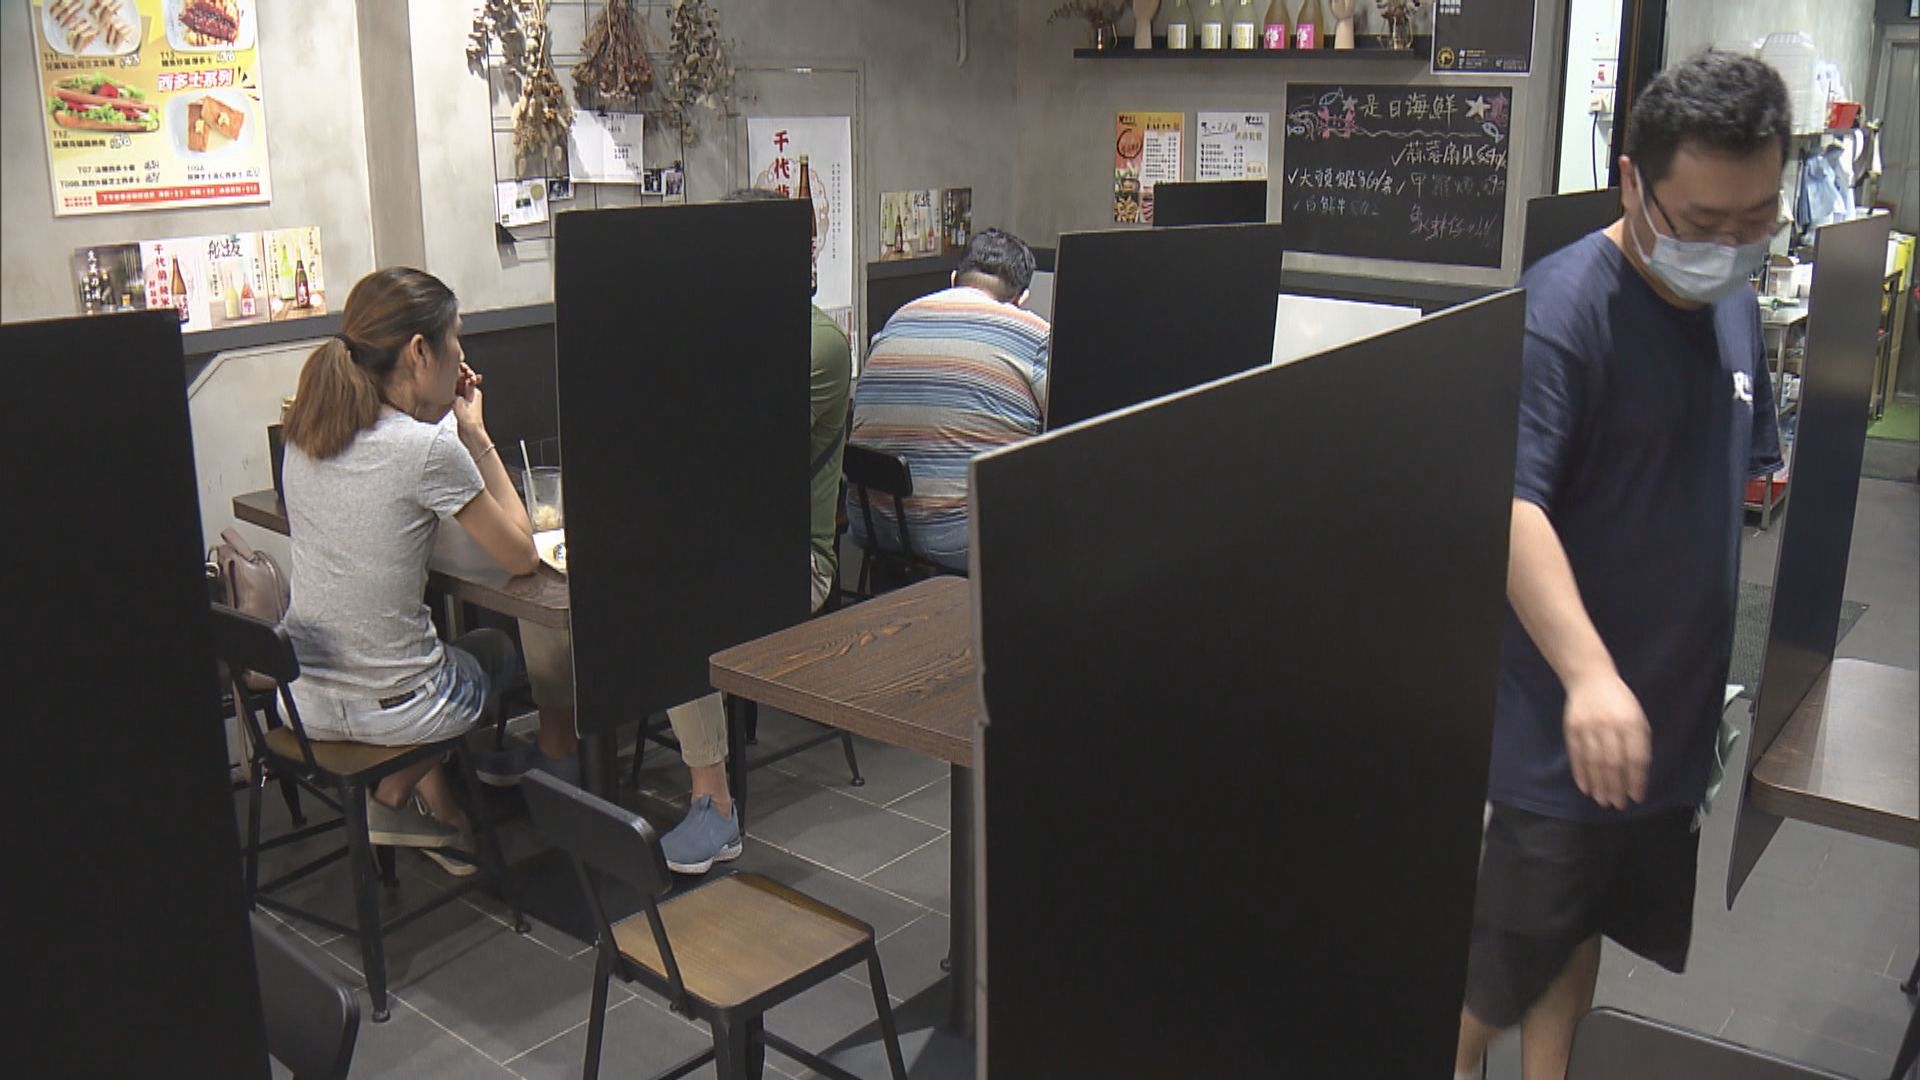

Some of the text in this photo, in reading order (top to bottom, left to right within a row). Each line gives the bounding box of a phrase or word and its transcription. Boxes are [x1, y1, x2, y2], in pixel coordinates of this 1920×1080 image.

[158, 69, 235, 92] 西多士系列
[1361, 93, 1459, 127] 是日海鮮
